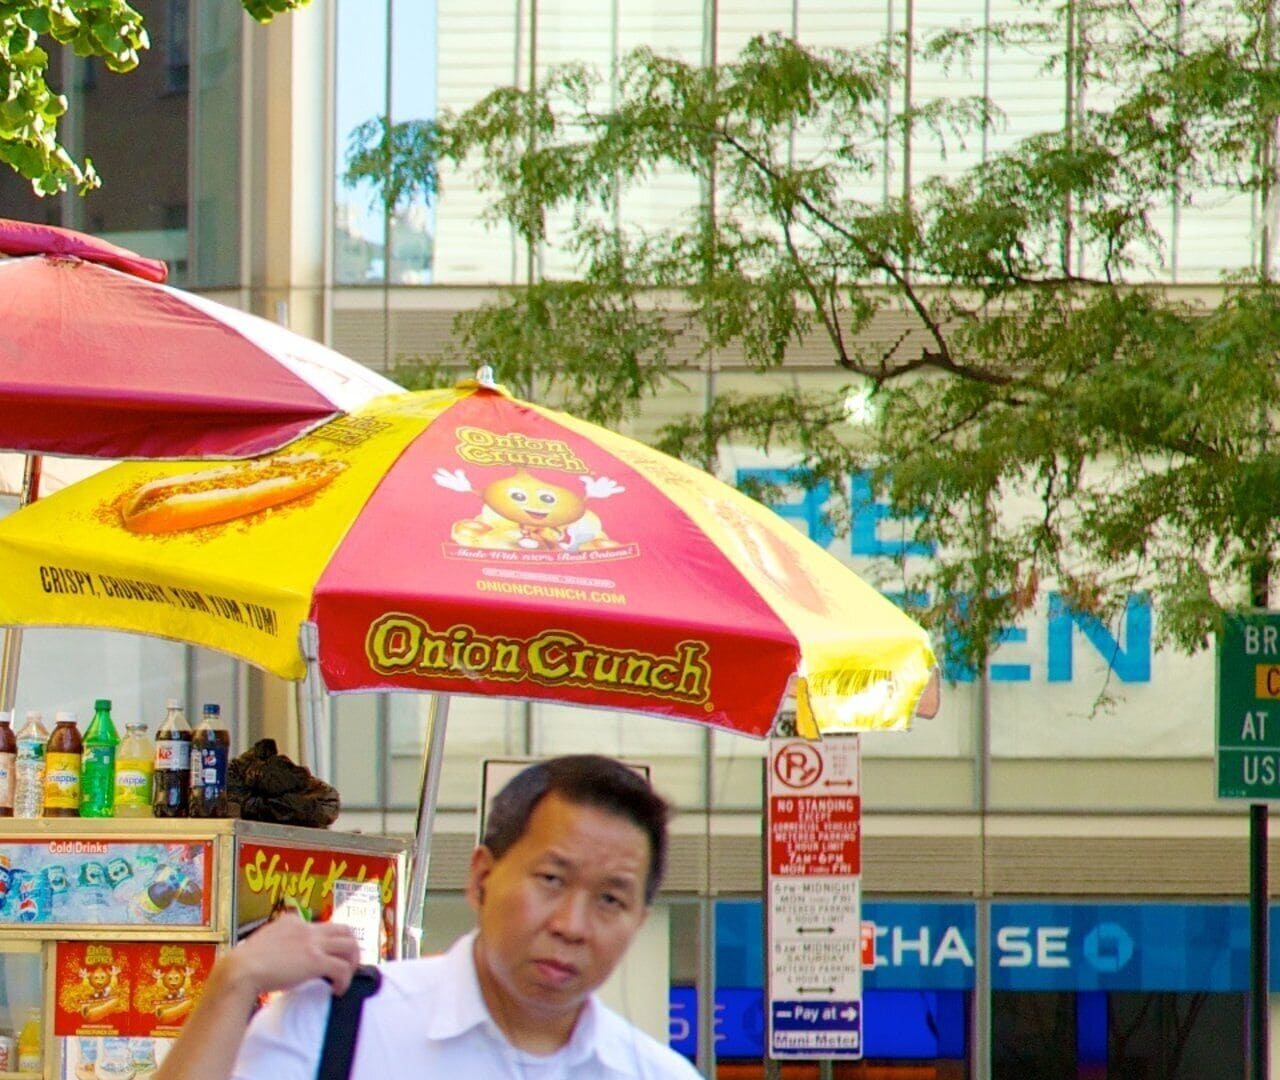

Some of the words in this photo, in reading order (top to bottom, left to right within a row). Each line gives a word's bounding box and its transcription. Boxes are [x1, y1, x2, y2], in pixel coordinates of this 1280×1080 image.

[458, 428, 571, 452] Onion
[458, 446, 586, 472] Crunch
[40, 565, 101, 599] CRISPY,
[476, 579, 628, 606] ONIONCRUNCH.COM
[1241, 711, 1268, 741] AT
[1243, 755, 1280, 785] US
[777, 800, 793, 812] NO
[797, 799, 854, 812] STANDING
[48, 843, 74, 854] Cold
[75, 843, 109, 854] Drinks
[780, 864, 806, 875] MON
[794, 1005, 820, 1023] Pay
[822, 1007, 838, 1020] at
